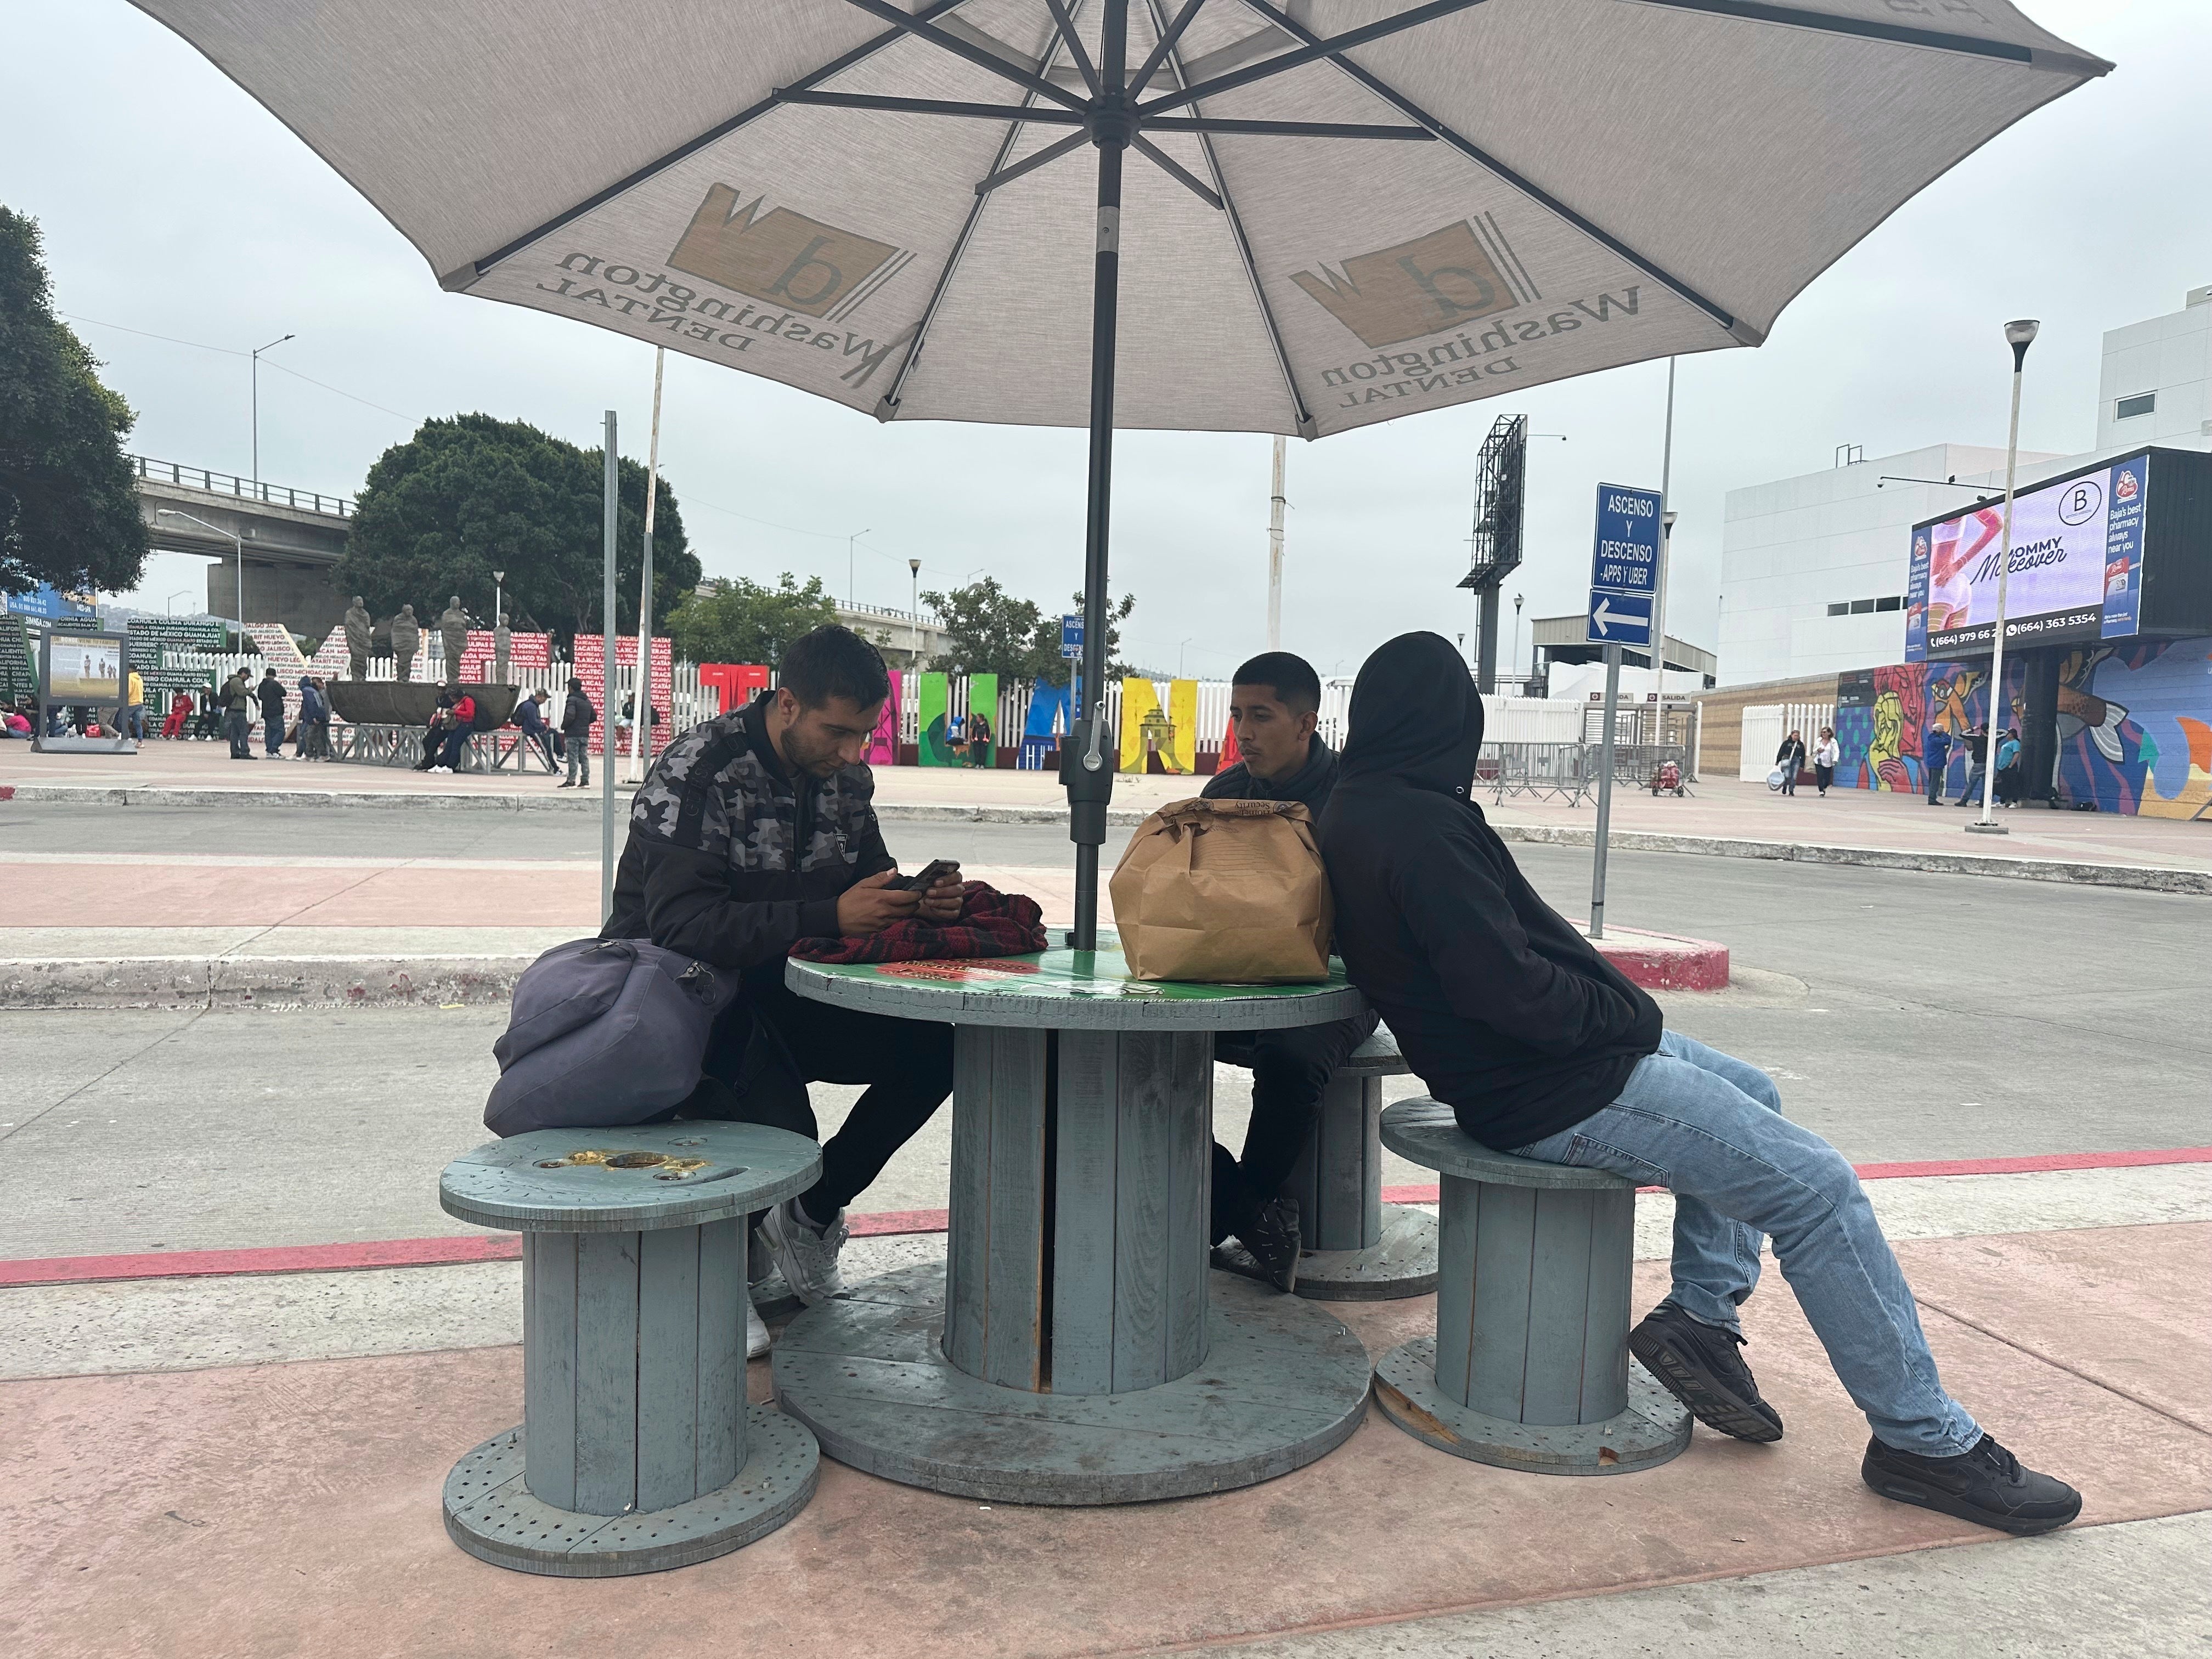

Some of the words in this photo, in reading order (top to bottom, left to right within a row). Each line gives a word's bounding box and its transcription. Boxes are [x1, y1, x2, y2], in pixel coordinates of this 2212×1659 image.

[1607, 494, 1653, 517] ASCENSO
[2074, 489, 2087, 512] B
[2111, 506, 2126, 521] Baja's
[2127, 503, 2142, 516] best
[1626, 520, 1633, 538] Y
[2109, 517, 2139, 534] pharmacy
[2109, 530, 2128, 543] always
[1600, 540, 1652, 562] DESCENSO
[2108, 543, 2121, 554] near
[2122, 540, 2134, 553] you
[1602, 563, 1622, 583] APPS
[1628, 567, 1648, 585] UBER
[1065, 620, 1084, 629] ASCENS
[2017, 621, 2044, 635] (664)
[2046, 617, 2066, 629] 363
[2068, 613, 2096, 626] 5354
[1074, 632, 1079, 641] Y
[1936, 634, 1957, 648] (664)
[1959, 631, 1976, 642] 979
[1978, 629, 1990, 640] 66
[1234, 800, 1271, 810] Security
